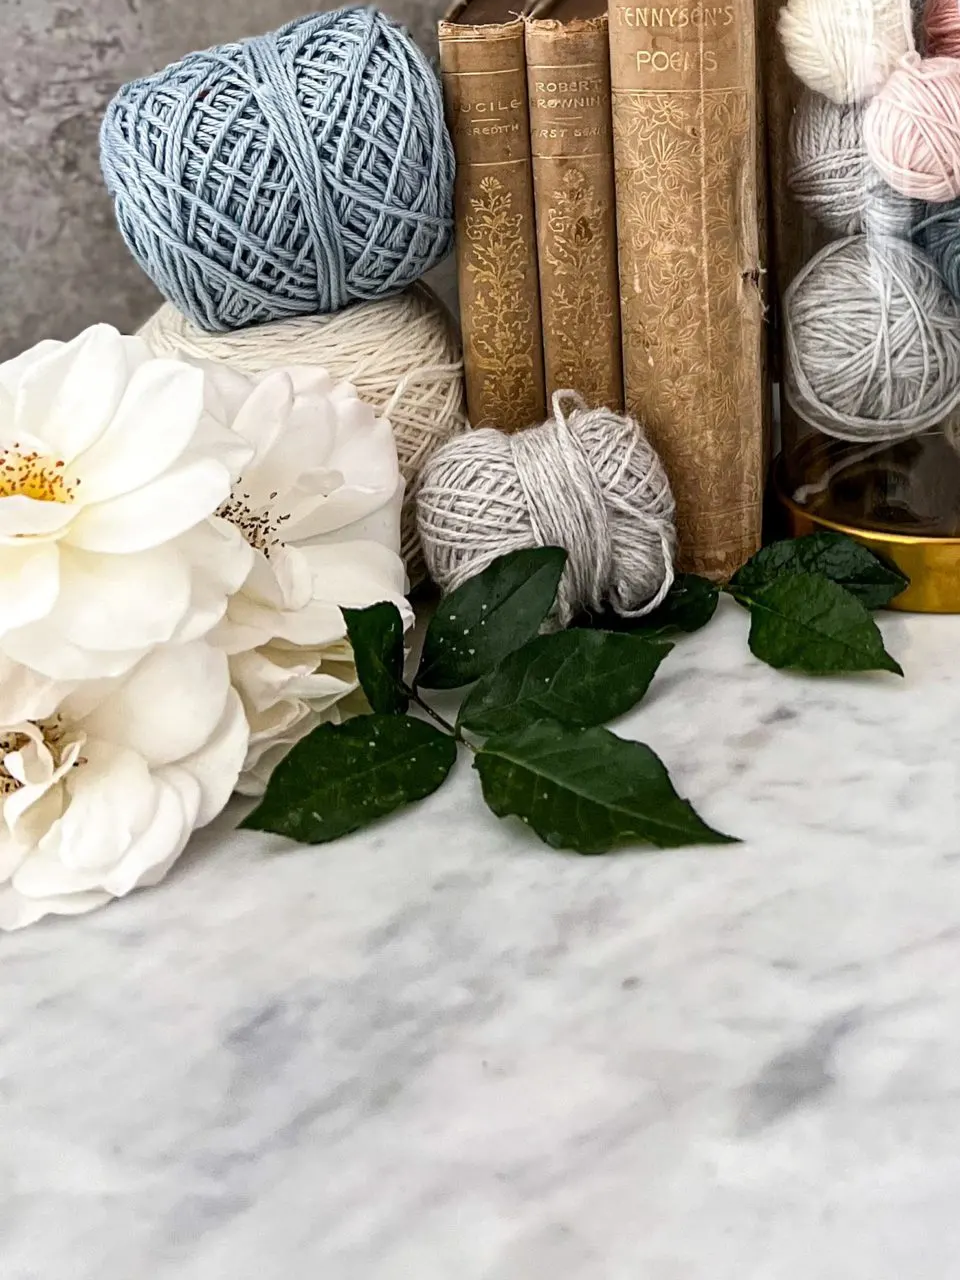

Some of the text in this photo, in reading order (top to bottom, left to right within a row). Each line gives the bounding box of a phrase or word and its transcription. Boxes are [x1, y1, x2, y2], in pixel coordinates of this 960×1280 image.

[616, 6, 734, 27] TENNYSON'S
[636, 50, 718, 73] POEMS
[535, 79, 603, 93] ROBERT
[456, 123, 519, 136] REDITH
[574, 127, 606, 138] SERI
